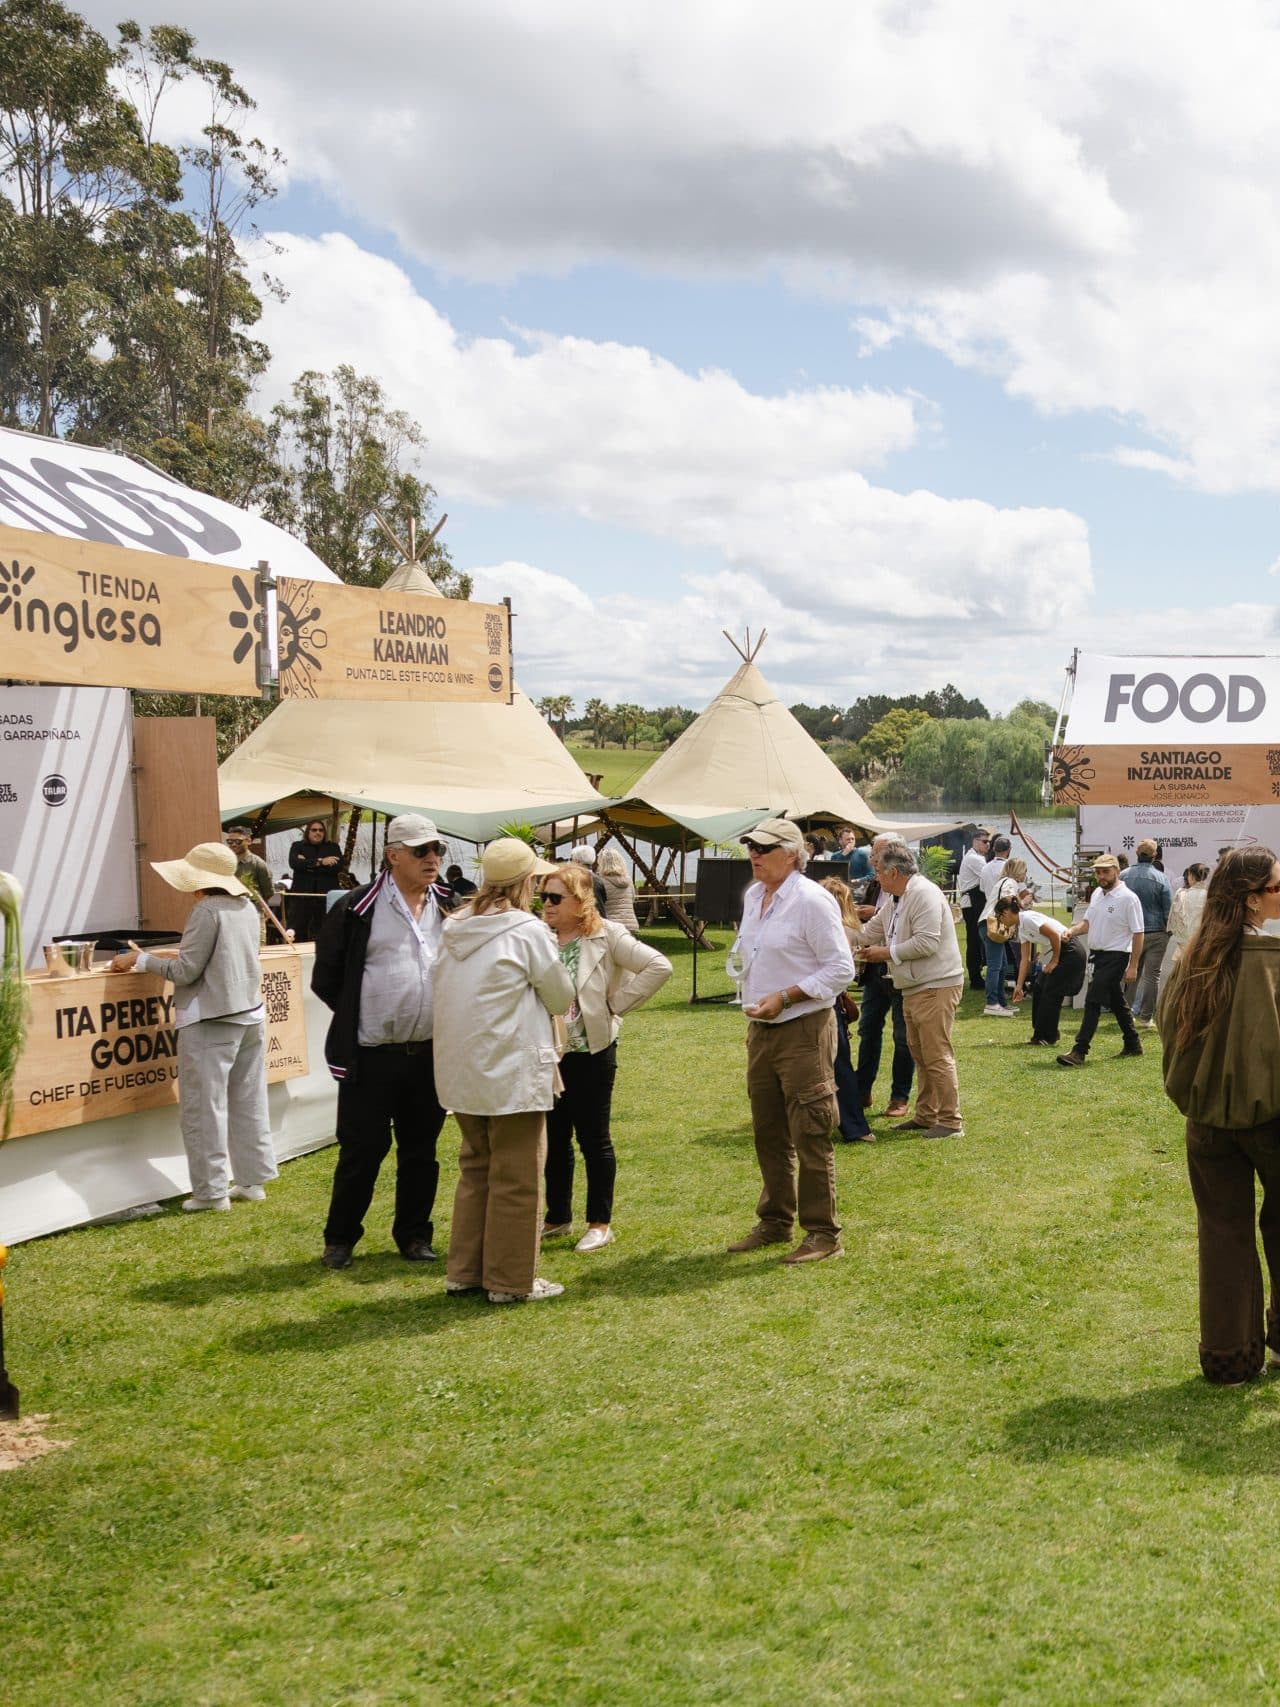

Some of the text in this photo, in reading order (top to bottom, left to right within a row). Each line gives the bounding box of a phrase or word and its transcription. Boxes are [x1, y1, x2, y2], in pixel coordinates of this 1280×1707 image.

[0, 457, 242, 559] OOD
[77, 570, 161, 604] TIENDA
[13, 600, 161, 653] inglesa
[379, 610, 446, 639] LEANDRO
[374, 638, 449, 666] KARAMAN
[346, 667, 379, 680] PUNTA
[380, 669, 398, 681] DEL
[400, 670, 420, 682] ESTE
[423, 671, 446, 683] FOOD
[455, 673, 474, 684] WINE
[1104, 672, 1266, 724] FOOD
[3, 728, 80, 741] GARRAPIÑADA
[1140, 751, 1222, 765] SANTIAGO
[1127, 766, 1232, 781] INZAURRALDE
[44, 786, 66, 796] TALAR
[1167, 783, 1207, 791] SUSANA
[263, 972, 289, 983] PUNTA
[261, 980, 292, 994] DEL ESTE
[266, 991, 288, 1003] FOOD
[272, 1001, 291, 1013] WINE
[56, 994, 176, 1039] ITA PEREY
[269, 1013, 289, 1024] 2025
[269, 1055, 303, 1070] AUSTRAL
[30, 1084, 75, 1106] CHEF
[80, 1080, 101, 1097] DE
[104, 1068, 167, 1093] FUEGOS
